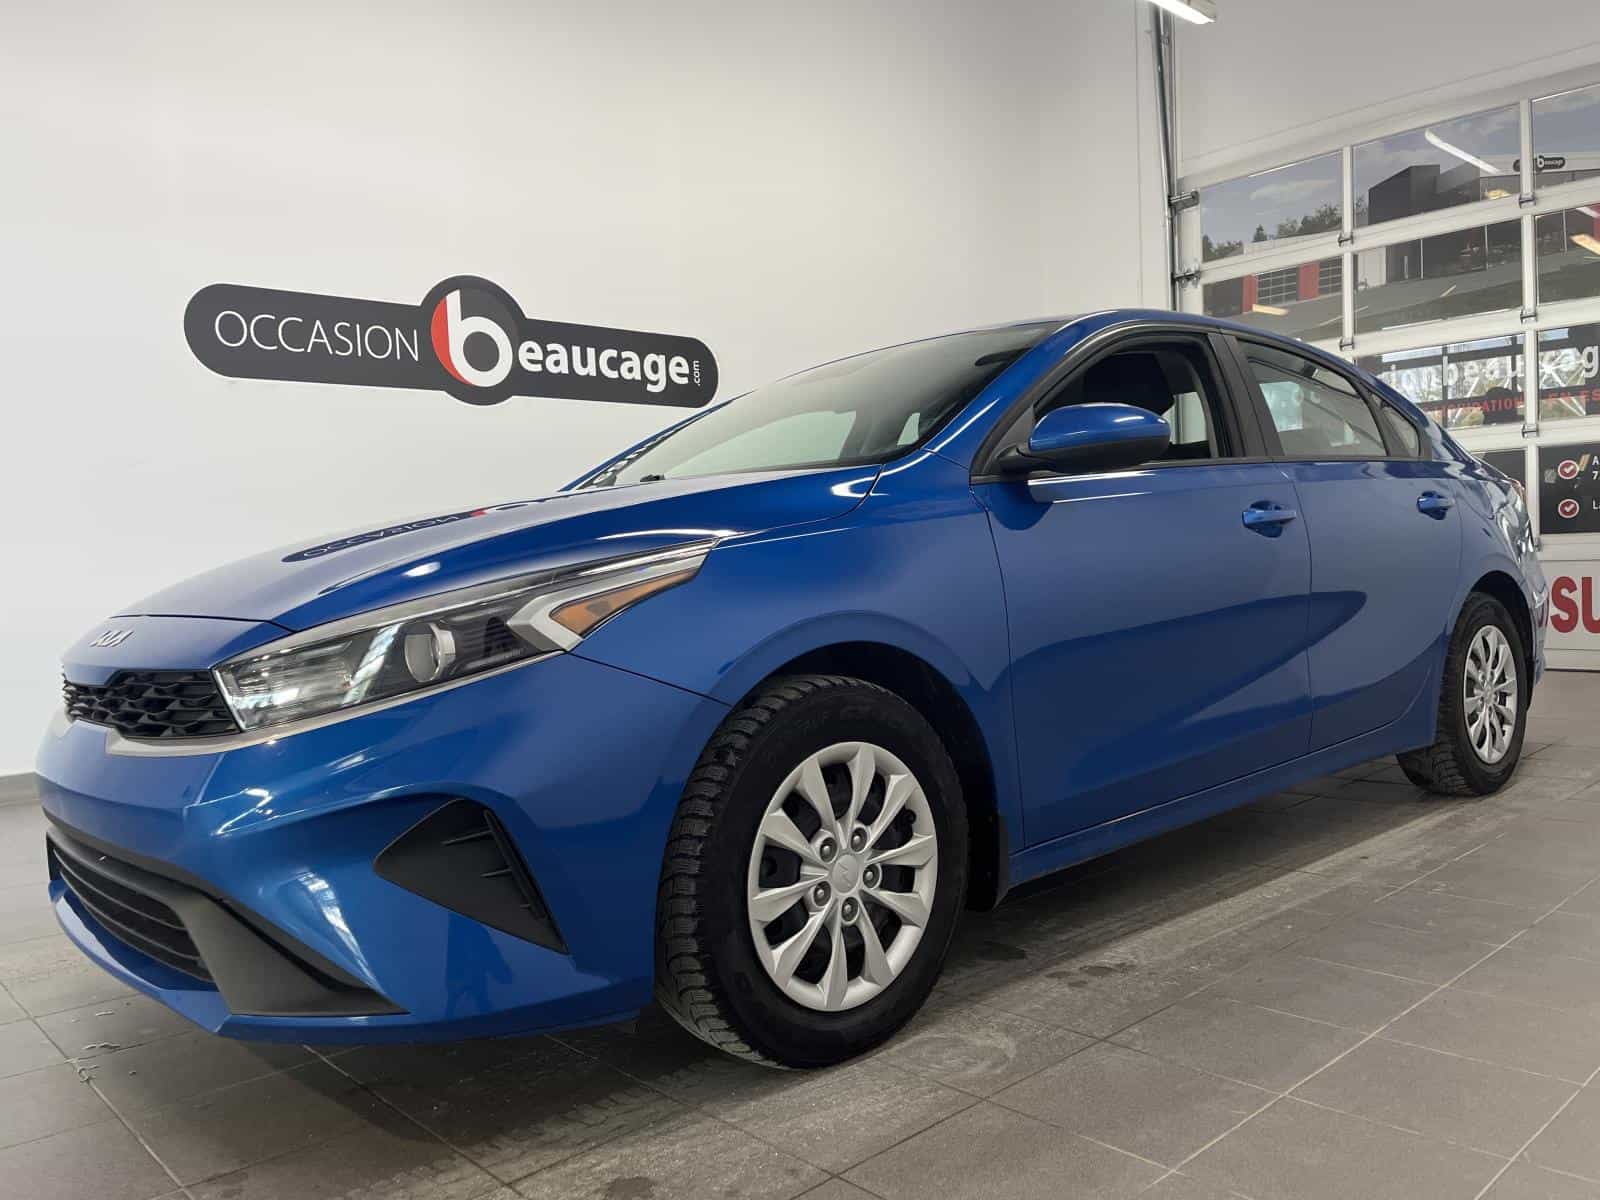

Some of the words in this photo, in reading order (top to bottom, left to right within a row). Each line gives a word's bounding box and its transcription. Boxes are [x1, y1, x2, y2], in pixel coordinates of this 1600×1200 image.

[214, 310, 419, 362] OCCASION
[444, 289, 690, 393] beaucage
[1547, 576, 1600, 634] SU
